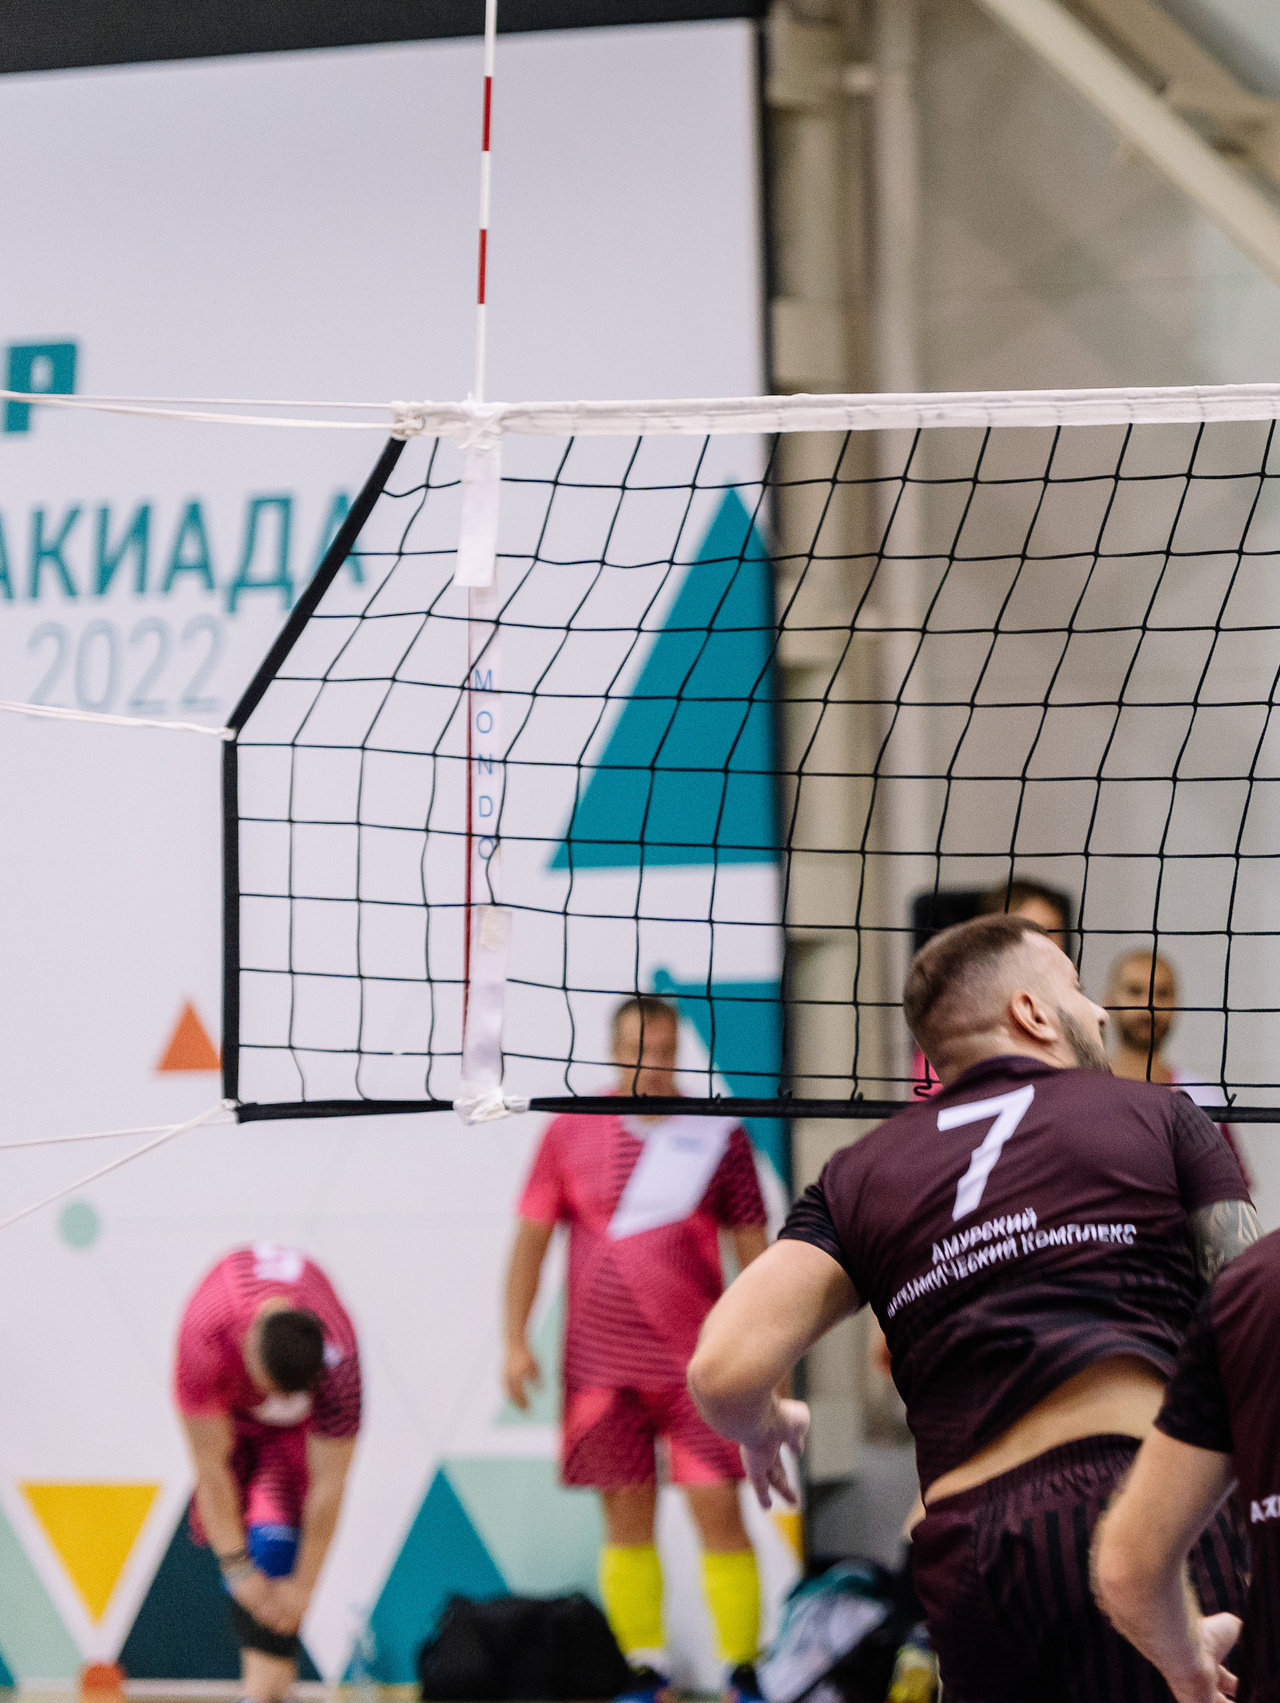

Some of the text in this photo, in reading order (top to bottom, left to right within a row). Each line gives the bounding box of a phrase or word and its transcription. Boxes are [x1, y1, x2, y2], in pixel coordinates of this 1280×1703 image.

[0, 489, 364, 614] КИАДА
[26, 614, 226, 717] 2022
[474, 668, 496, 861] MONDO
[936, 1083, 1035, 1222] 7
[931, 1206, 1038, 1265] АМУРСКИЙ
[1020, 1223, 1137, 1256] КОМПЛЕКС
